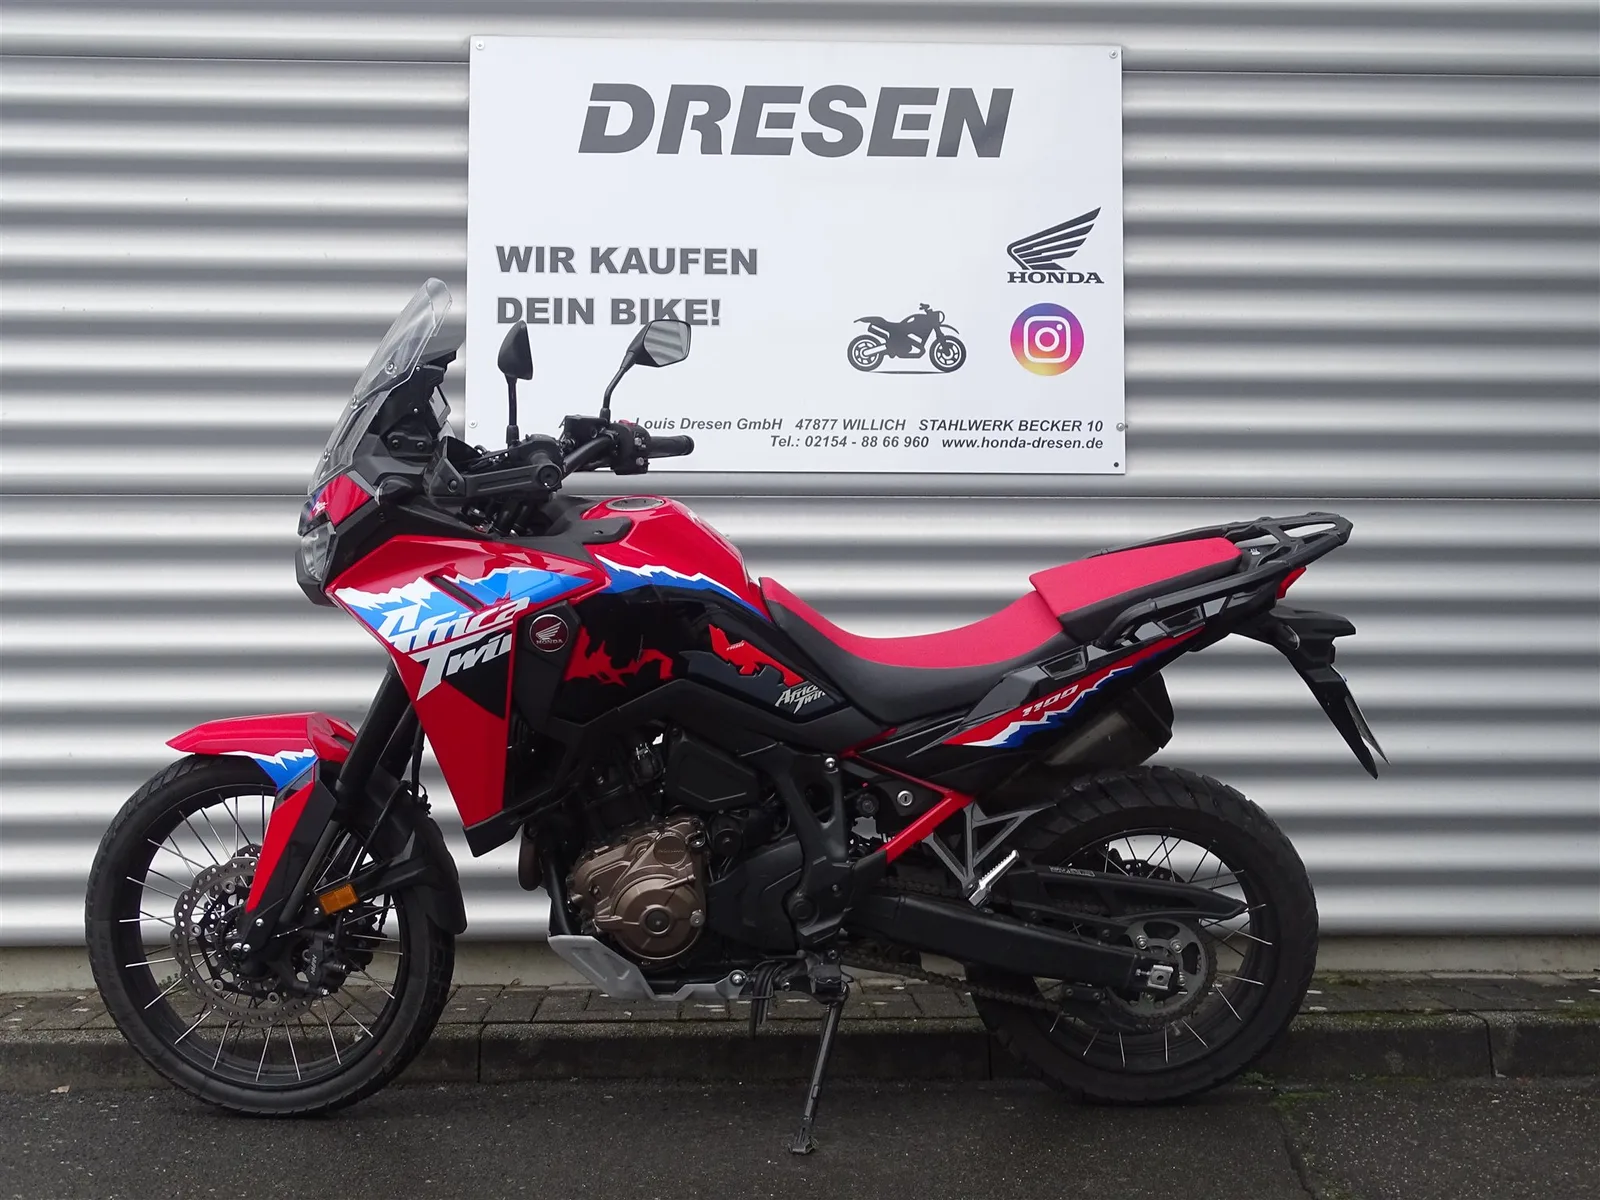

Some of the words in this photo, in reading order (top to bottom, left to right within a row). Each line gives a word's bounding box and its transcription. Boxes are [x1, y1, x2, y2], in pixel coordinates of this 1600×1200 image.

[578, 83, 1014, 158] DRESEN
[496, 246, 576, 273] WIR
[590, 247, 758, 275] KAUFEN
[1007, 271, 1105, 284] HONDA
[498, 297, 594, 324] DEIN
[611, 298, 720, 325] BIKE!
[680, 417, 732, 430] Dresen
[737, 418, 783, 430] GmbH
[795, 418, 838, 430] 47877
[843, 418, 906, 431] WILLICH
[919, 419, 1014, 432] STAHLWERK
[1018, 419, 1083, 432] BECKER
[1087, 420, 1104, 432] 10
[771, 435, 800, 448] Tel.:
[804, 436, 848, 448] 02154
[861, 436, 878, 448] 88
[882, 436, 900, 448] 66
[904, 436, 930, 448] 960
[942, 436, 1104, 449] www.honda-dresen.de
[377, 596, 530, 653] Africa
[1022, 684, 1079, 718] 1100
